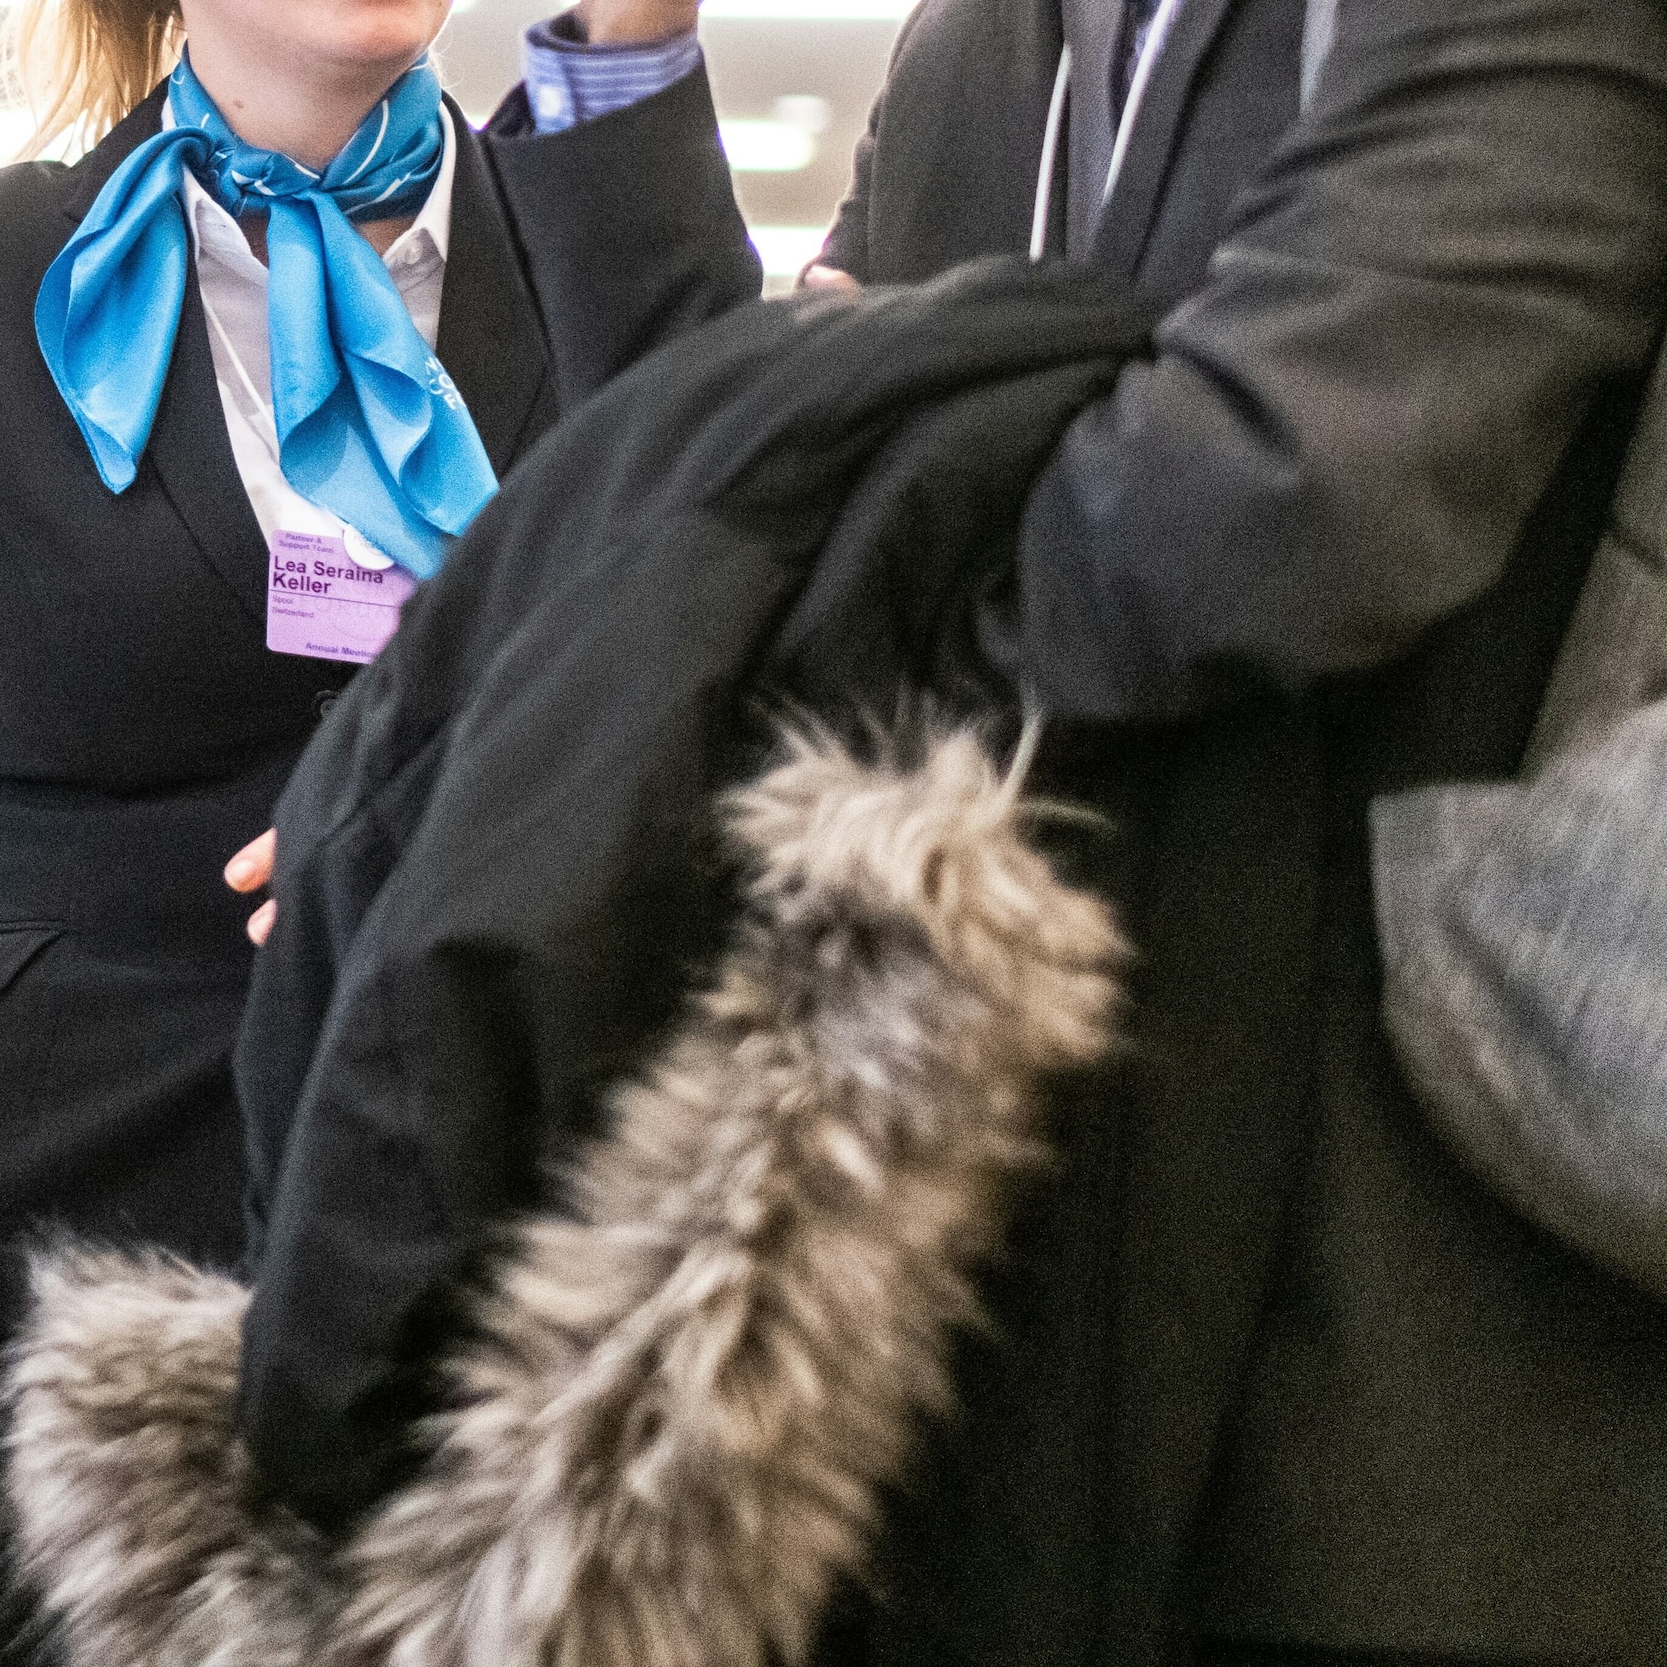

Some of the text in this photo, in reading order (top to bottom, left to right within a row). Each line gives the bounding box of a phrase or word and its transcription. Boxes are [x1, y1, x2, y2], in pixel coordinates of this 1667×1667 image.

[279, 539, 334, 554] Support Team
[274, 555, 384, 584] Lea Seraina
[273, 572, 332, 594] Keller
